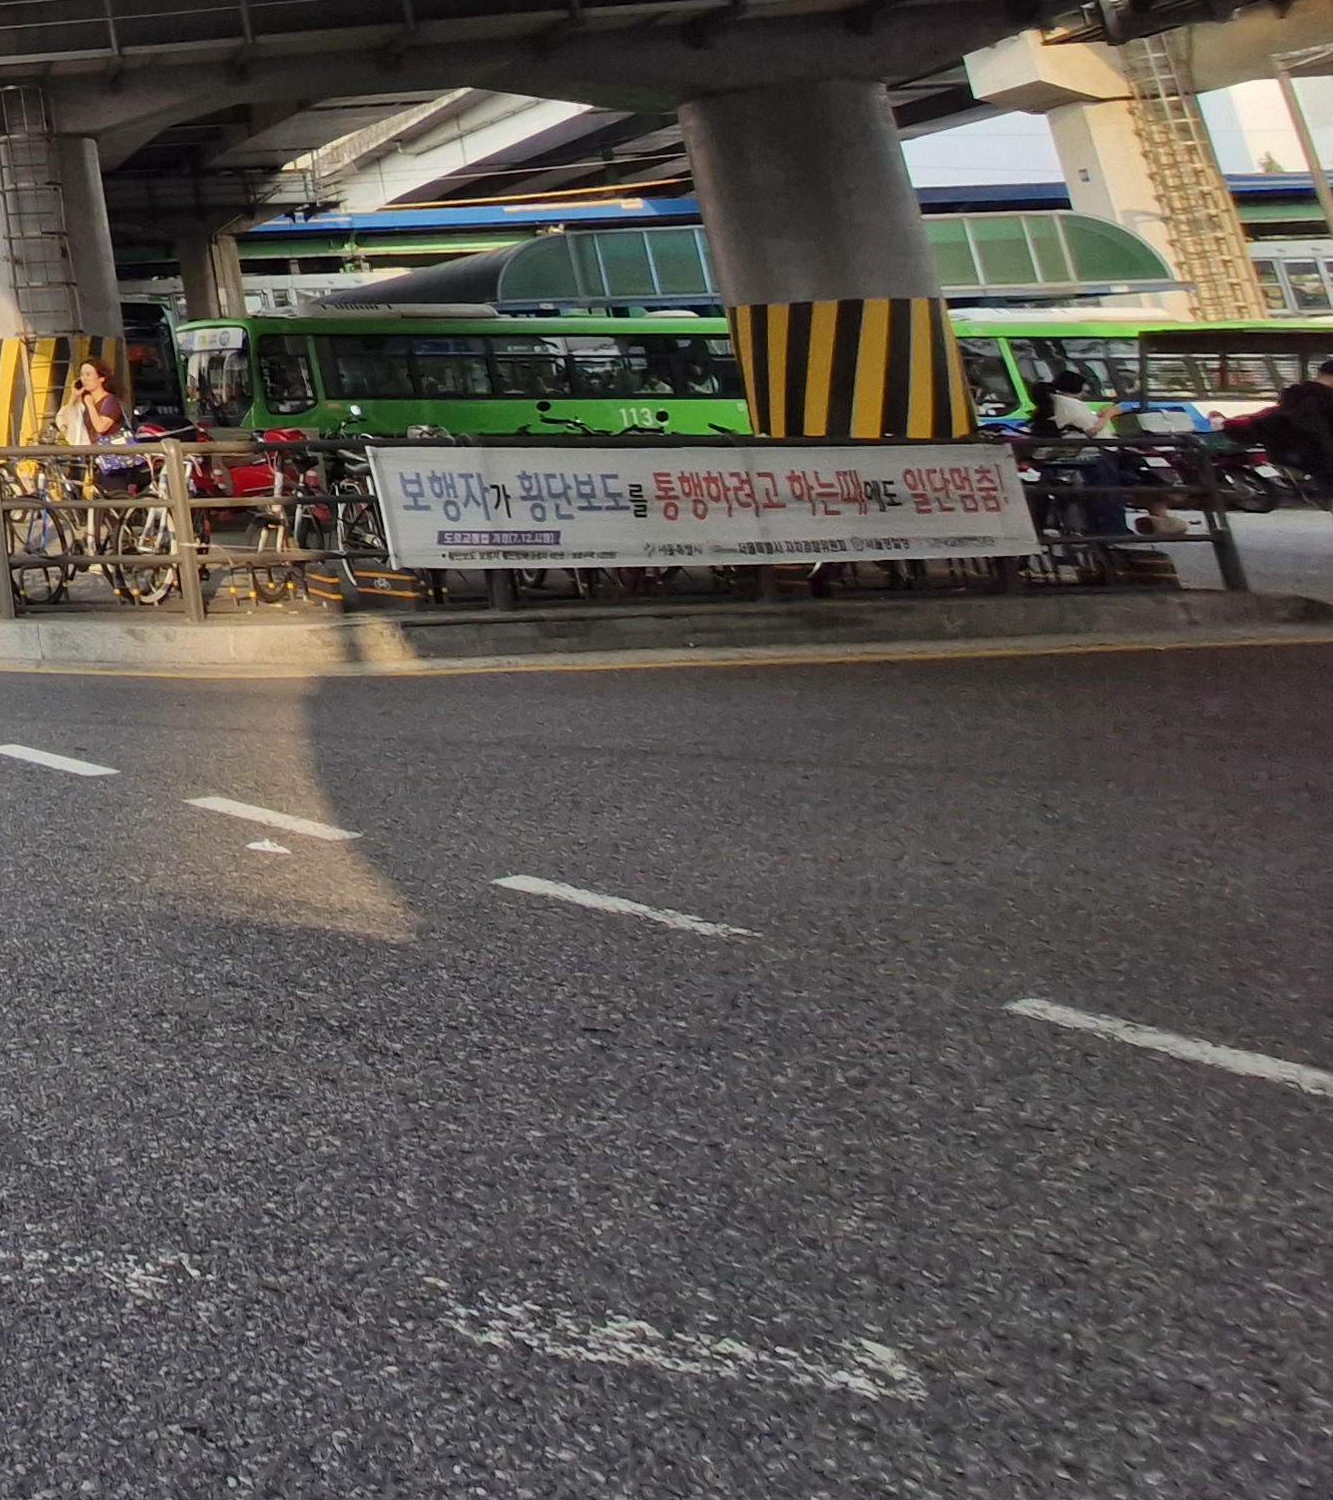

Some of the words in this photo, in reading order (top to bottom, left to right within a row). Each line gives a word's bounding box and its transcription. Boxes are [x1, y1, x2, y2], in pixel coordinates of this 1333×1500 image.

[619, 407, 670, 427] 113
[399, 469, 512, 523] 보행자가
[516, 469, 649, 523] 횡단보도를
[652, 469, 787, 522] 통행하려고
